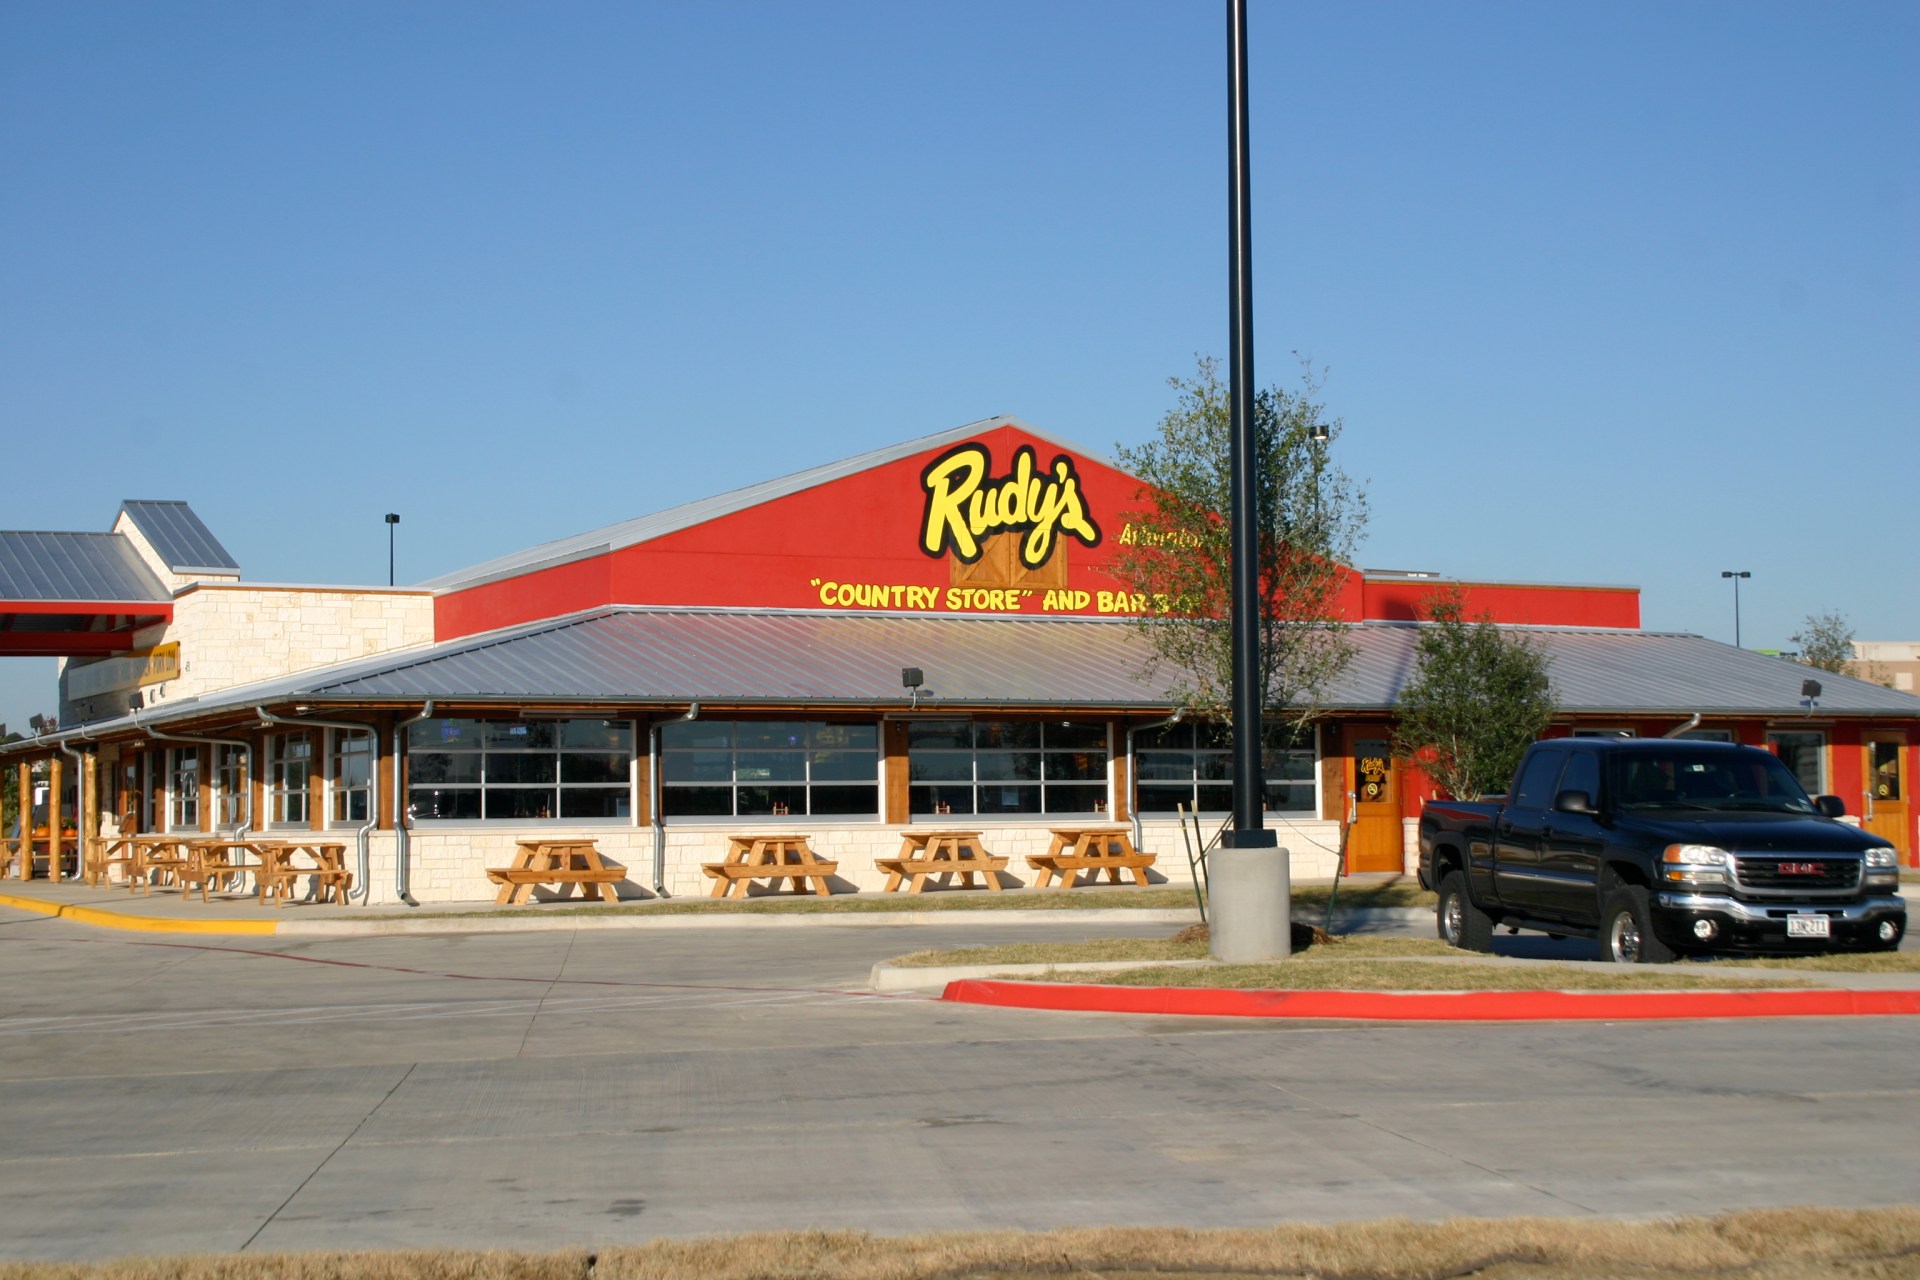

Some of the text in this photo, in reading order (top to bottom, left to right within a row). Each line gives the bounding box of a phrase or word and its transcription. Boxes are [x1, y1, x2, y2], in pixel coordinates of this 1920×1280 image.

[922, 446, 1099, 567] Rudy's
[1042, 589, 1091, 611] AND
[1778, 863, 1825, 875] GMC
